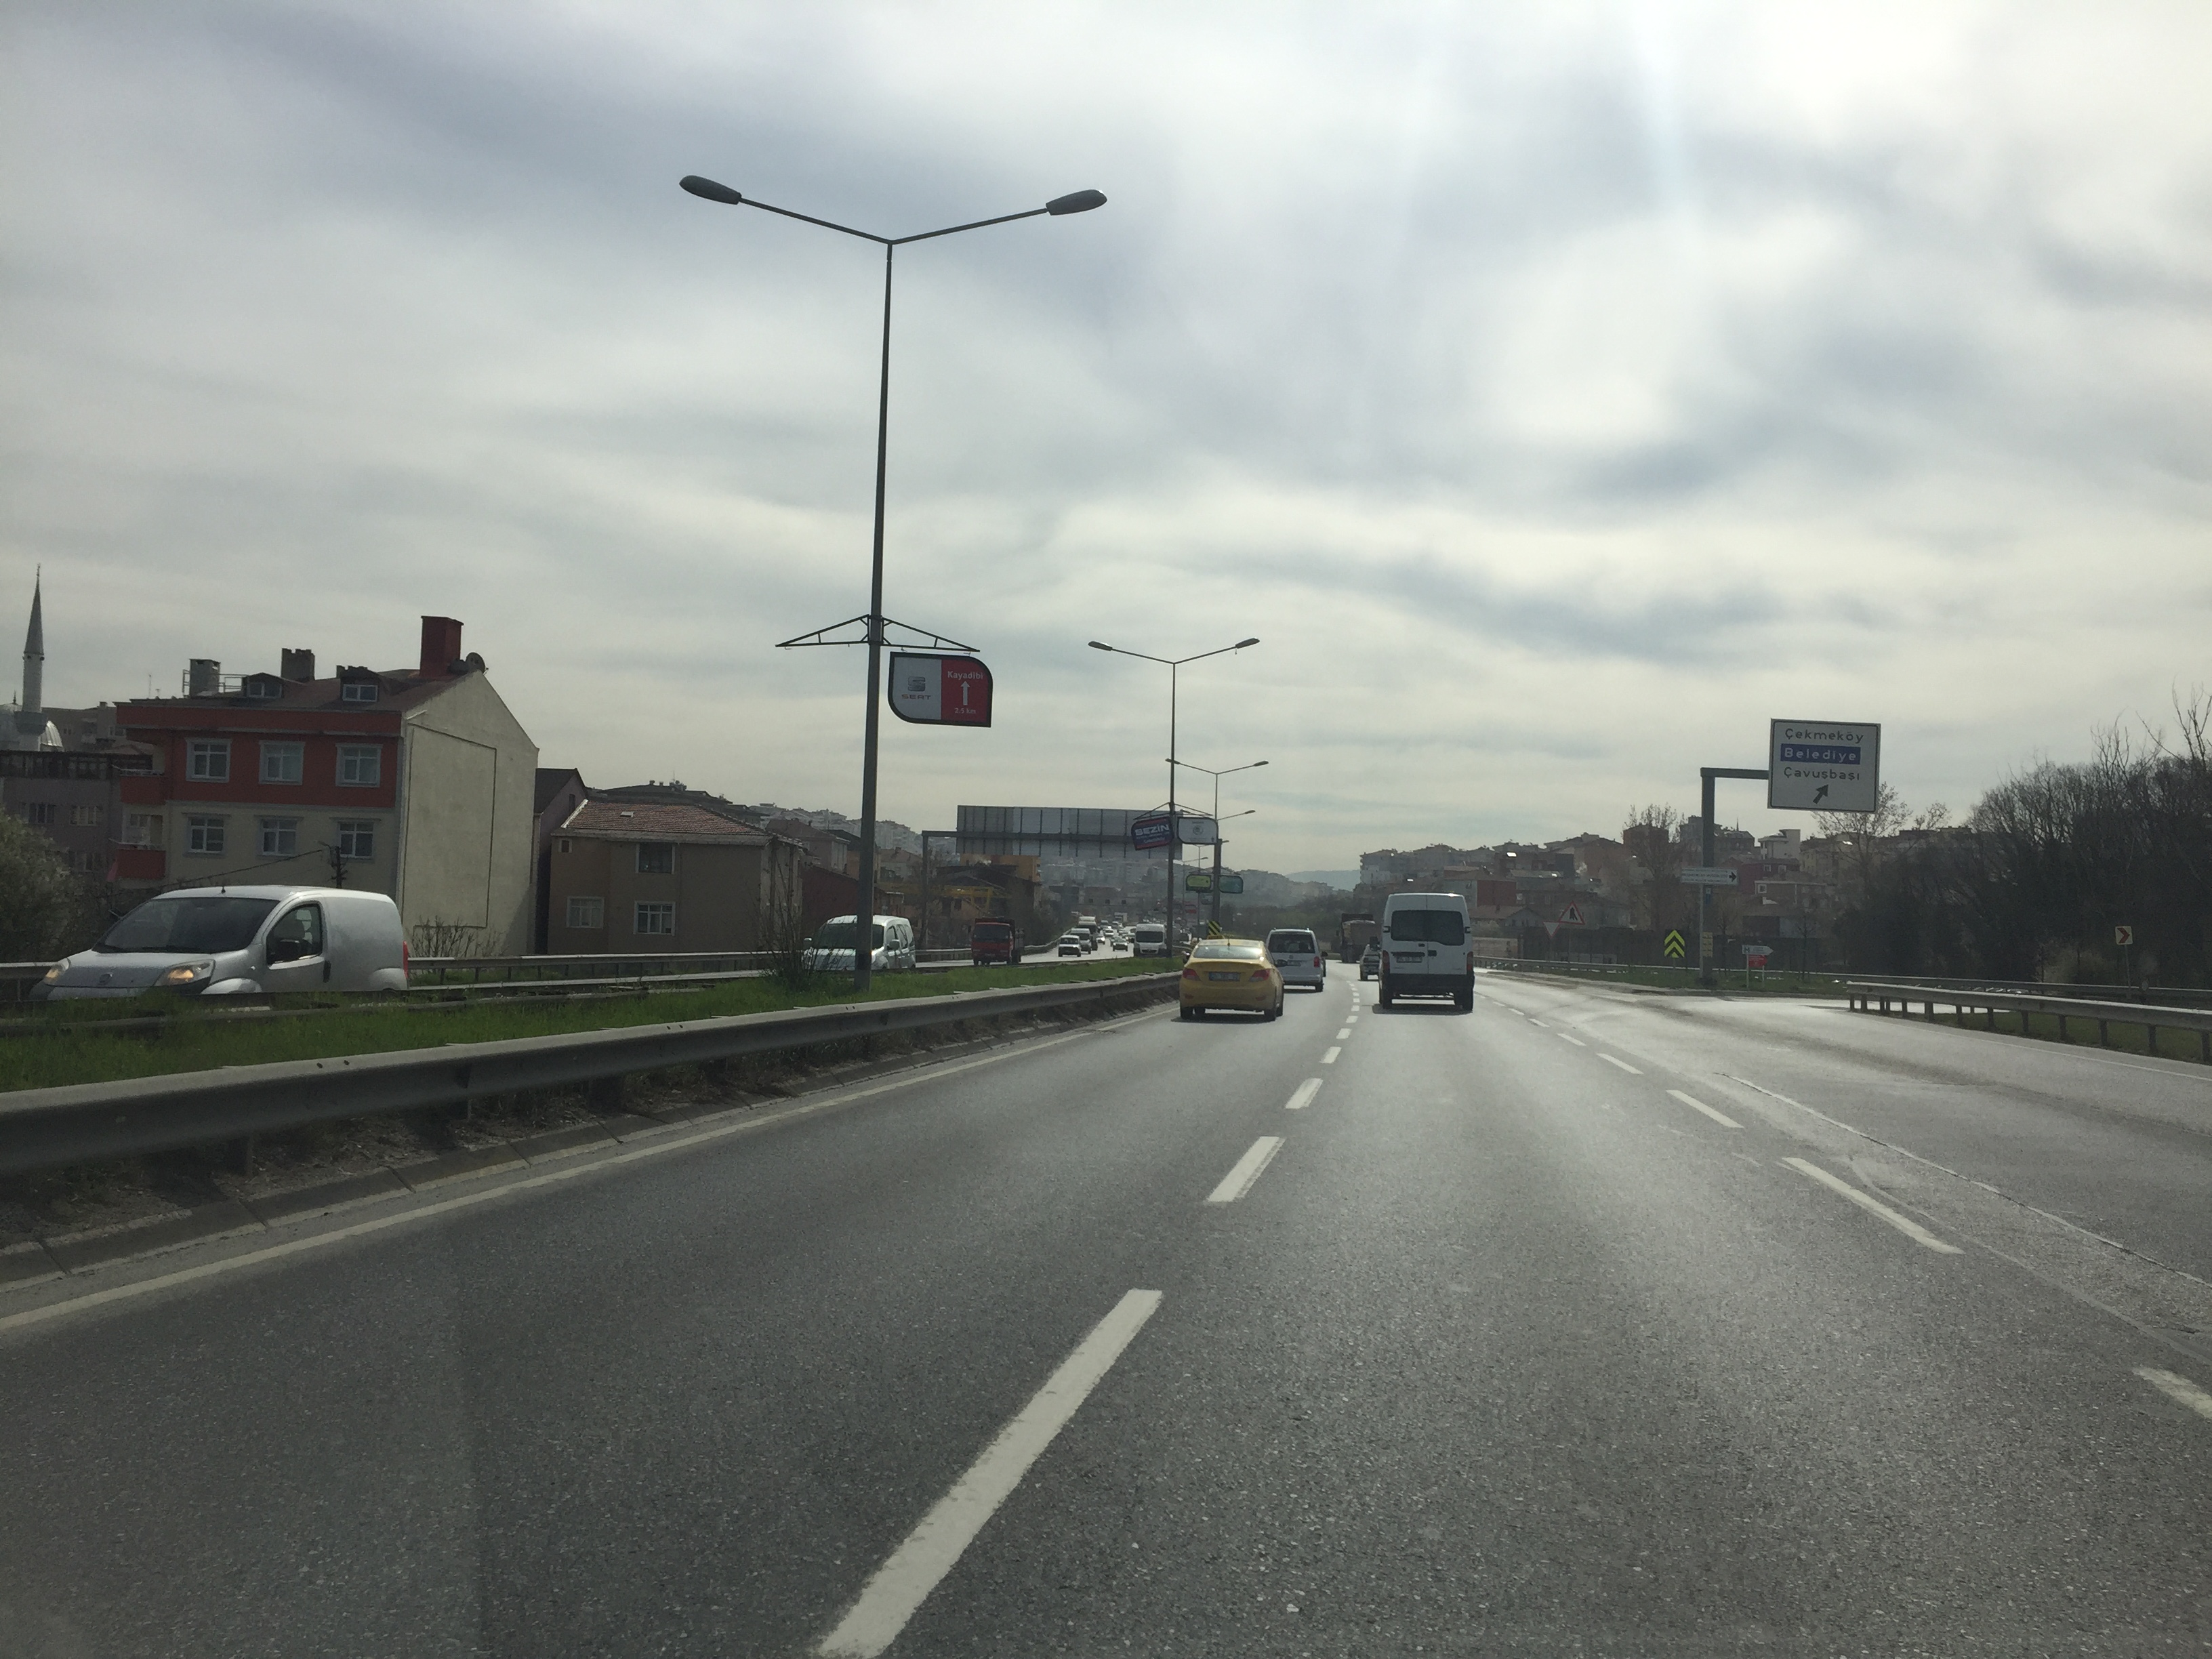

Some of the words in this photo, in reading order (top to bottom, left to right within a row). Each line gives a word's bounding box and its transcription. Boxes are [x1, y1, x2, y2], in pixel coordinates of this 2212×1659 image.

[947, 671, 984, 680] Kayadibi
[1785, 728, 1864, 743] Çekmeköy
[1784, 747, 1857, 762] Belediye
[1784, 766, 1860, 781] Çavuşbaşı
